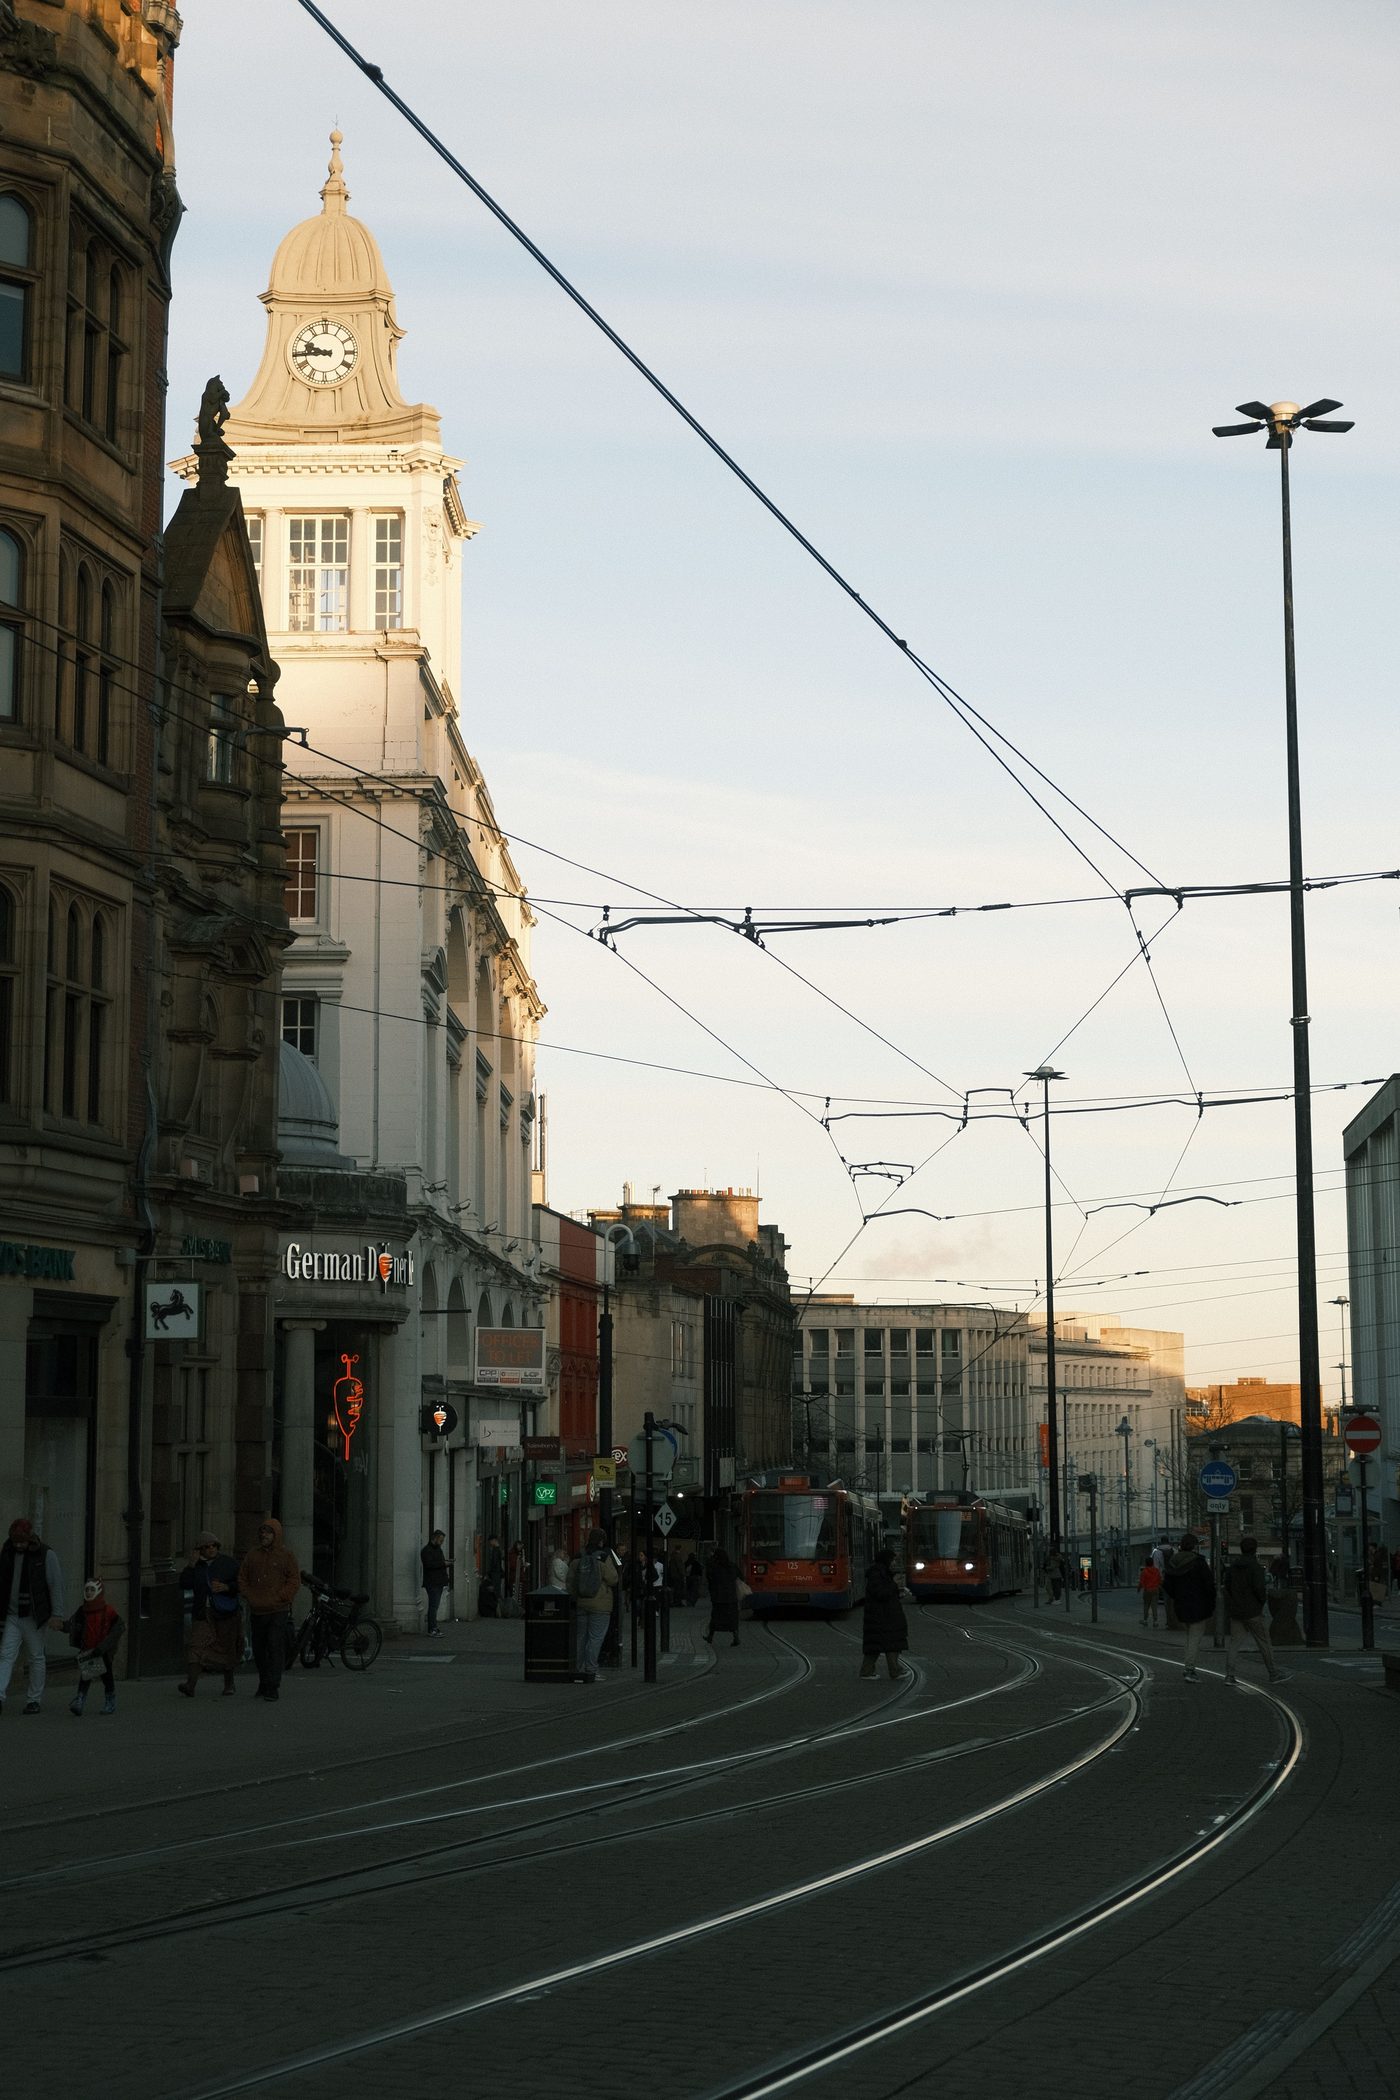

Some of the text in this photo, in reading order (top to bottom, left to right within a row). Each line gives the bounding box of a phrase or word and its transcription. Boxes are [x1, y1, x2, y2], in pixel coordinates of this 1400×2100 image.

[25, 1245, 76, 1280] BANK
[286, 1242, 362, 1282] German
[535, 1486, 555, 1499] VPZ
[658, 1512, 672, 1526] 15
[787, 1561, 799, 1570] 125
